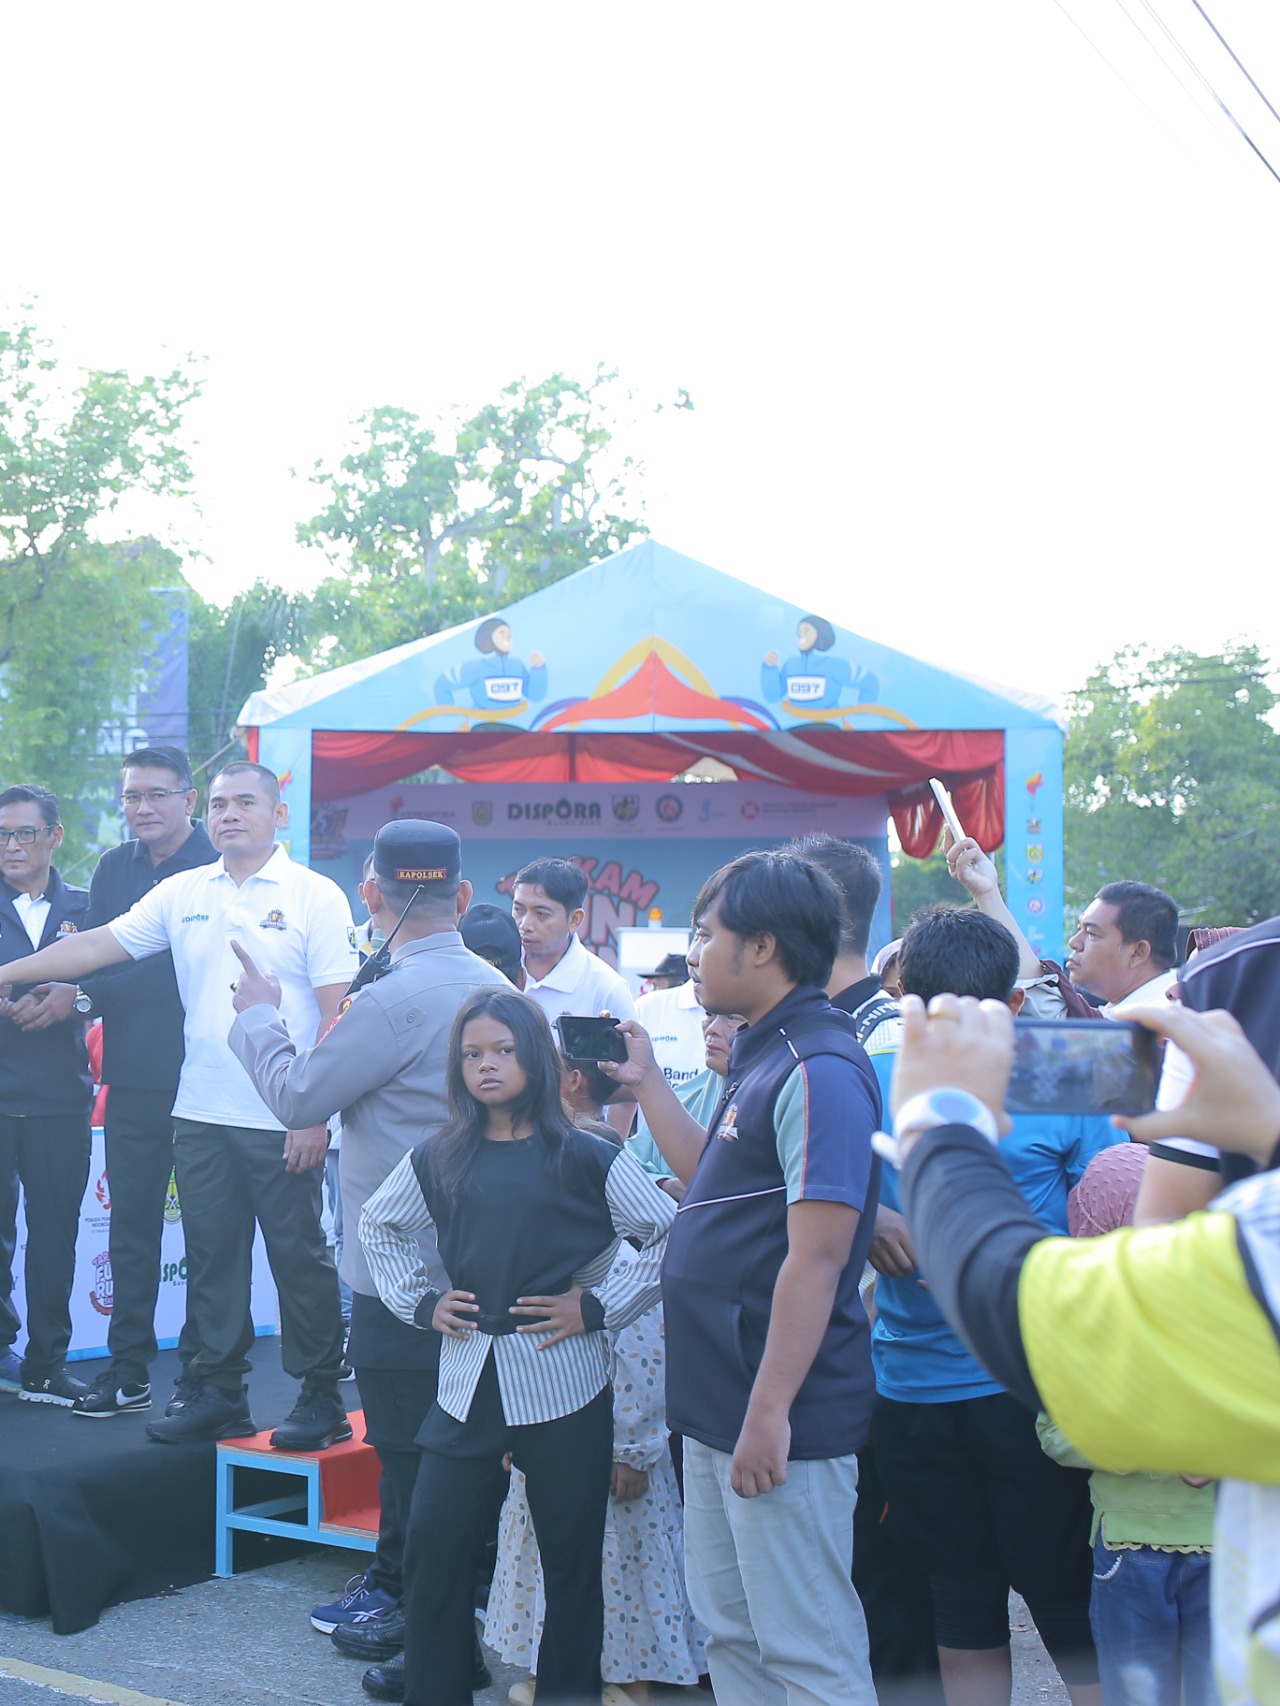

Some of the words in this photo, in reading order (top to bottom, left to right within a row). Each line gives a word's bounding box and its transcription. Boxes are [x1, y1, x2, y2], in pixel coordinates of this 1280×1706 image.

[399, 870, 444, 880] KAPOLSEK
[91, 1250, 110, 1267] TAR
[96, 1263, 112, 1285] FU
[96, 1281, 113, 1300] RU
